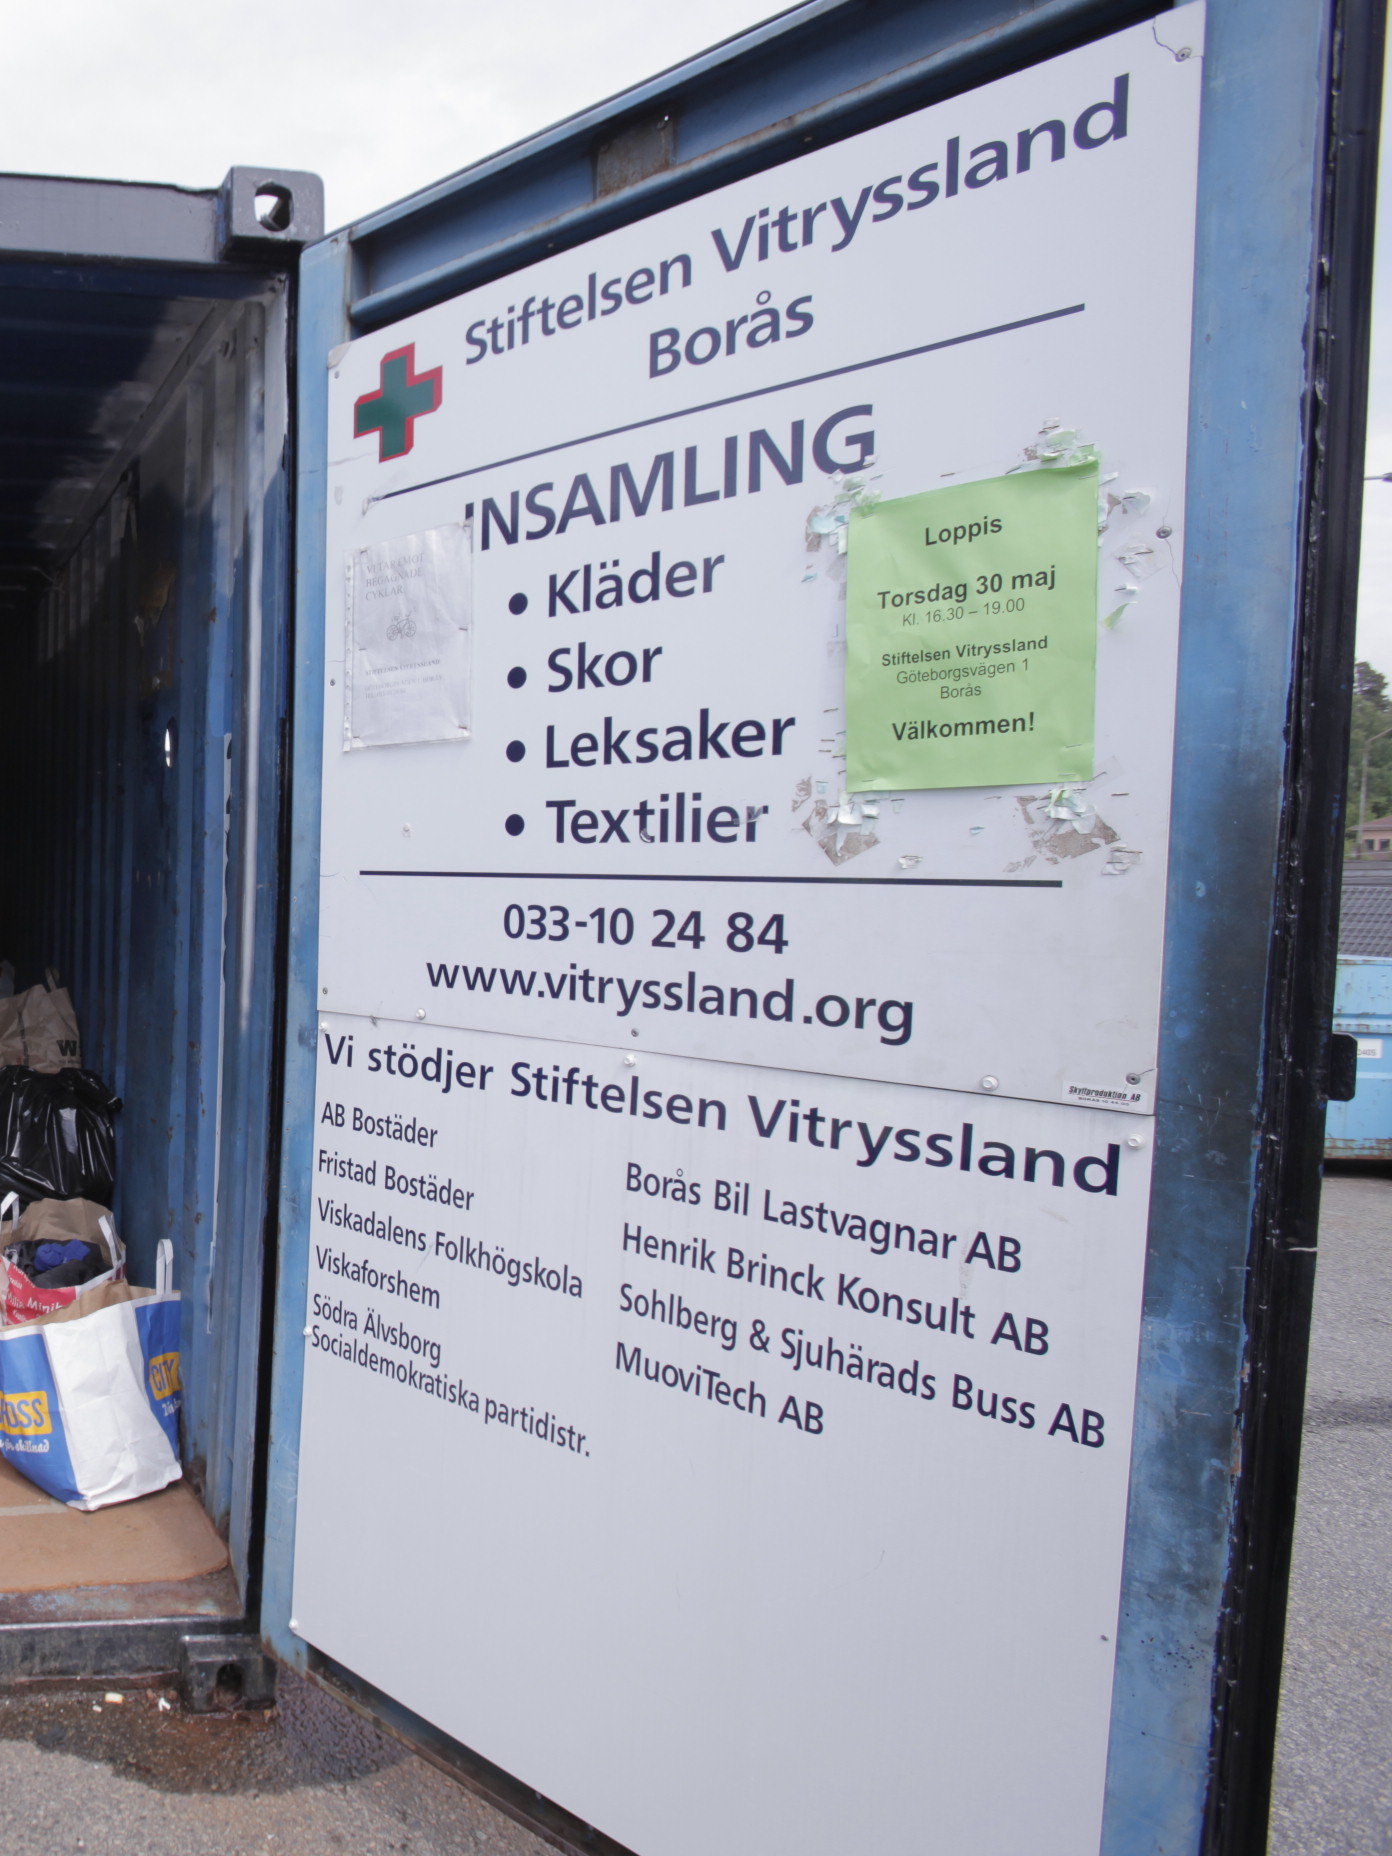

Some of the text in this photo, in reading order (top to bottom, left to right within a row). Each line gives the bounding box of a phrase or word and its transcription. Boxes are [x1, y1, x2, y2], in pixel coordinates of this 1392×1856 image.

[464, 72, 1130, 365] Stiftelsen Vitryssland
[648, 290, 814, 379] Borås
[924, 515, 1003, 546] Loppis
[547, 550, 726, 619] Kläder
[877, 565, 1056, 609] Torsdag 30 maj
[902, 613, 920, 627] Kl.
[925, 606, 964, 624] 16.30
[983, 597, 1026, 615] 19.00
[546, 641, 664, 693] Skor
[881, 635, 1048, 667] Stiftelsen Vitryssland
[896, 658, 1030, 684] Göteborgsvägen 1
[940, 683, 982, 700] Borås
[545, 707, 797, 769] Leksaker
[892, 711, 1036, 742] Välkommen!
[545, 791, 770, 844] Textilier
[503, 903, 790, 955] 033-10 24 84
[426, 957, 914, 1047] www.vitryssland.org
[320, 1101, 438, 1149] AB Bostäder
[324, 1032, 1121, 1197] Vi stödjer Stiftelsen Vitryssland
[1130, 1093, 1141, 1102] AB
[318, 1148, 475, 1212] Fristad Bostäder
[317, 1197, 583, 1299] Viskadalens Folkhögskola
[626, 1161, 1022, 1274] Borås Bil Lastvagnar AB
[315, 1245, 440, 1311] Viskaforshem
[622, 1222, 1049, 1357] Henrik Brinck Konsult AB
[313, 1293, 442, 1370] Södra Älvsborg
[311, 1324, 592, 1458] Socialdemokratiska partidistr.
[615, 1341, 824, 1435] MuoviTech AB
[619, 1283, 1106, 1449] Sohlberg & Sjuhärads Buss AB
